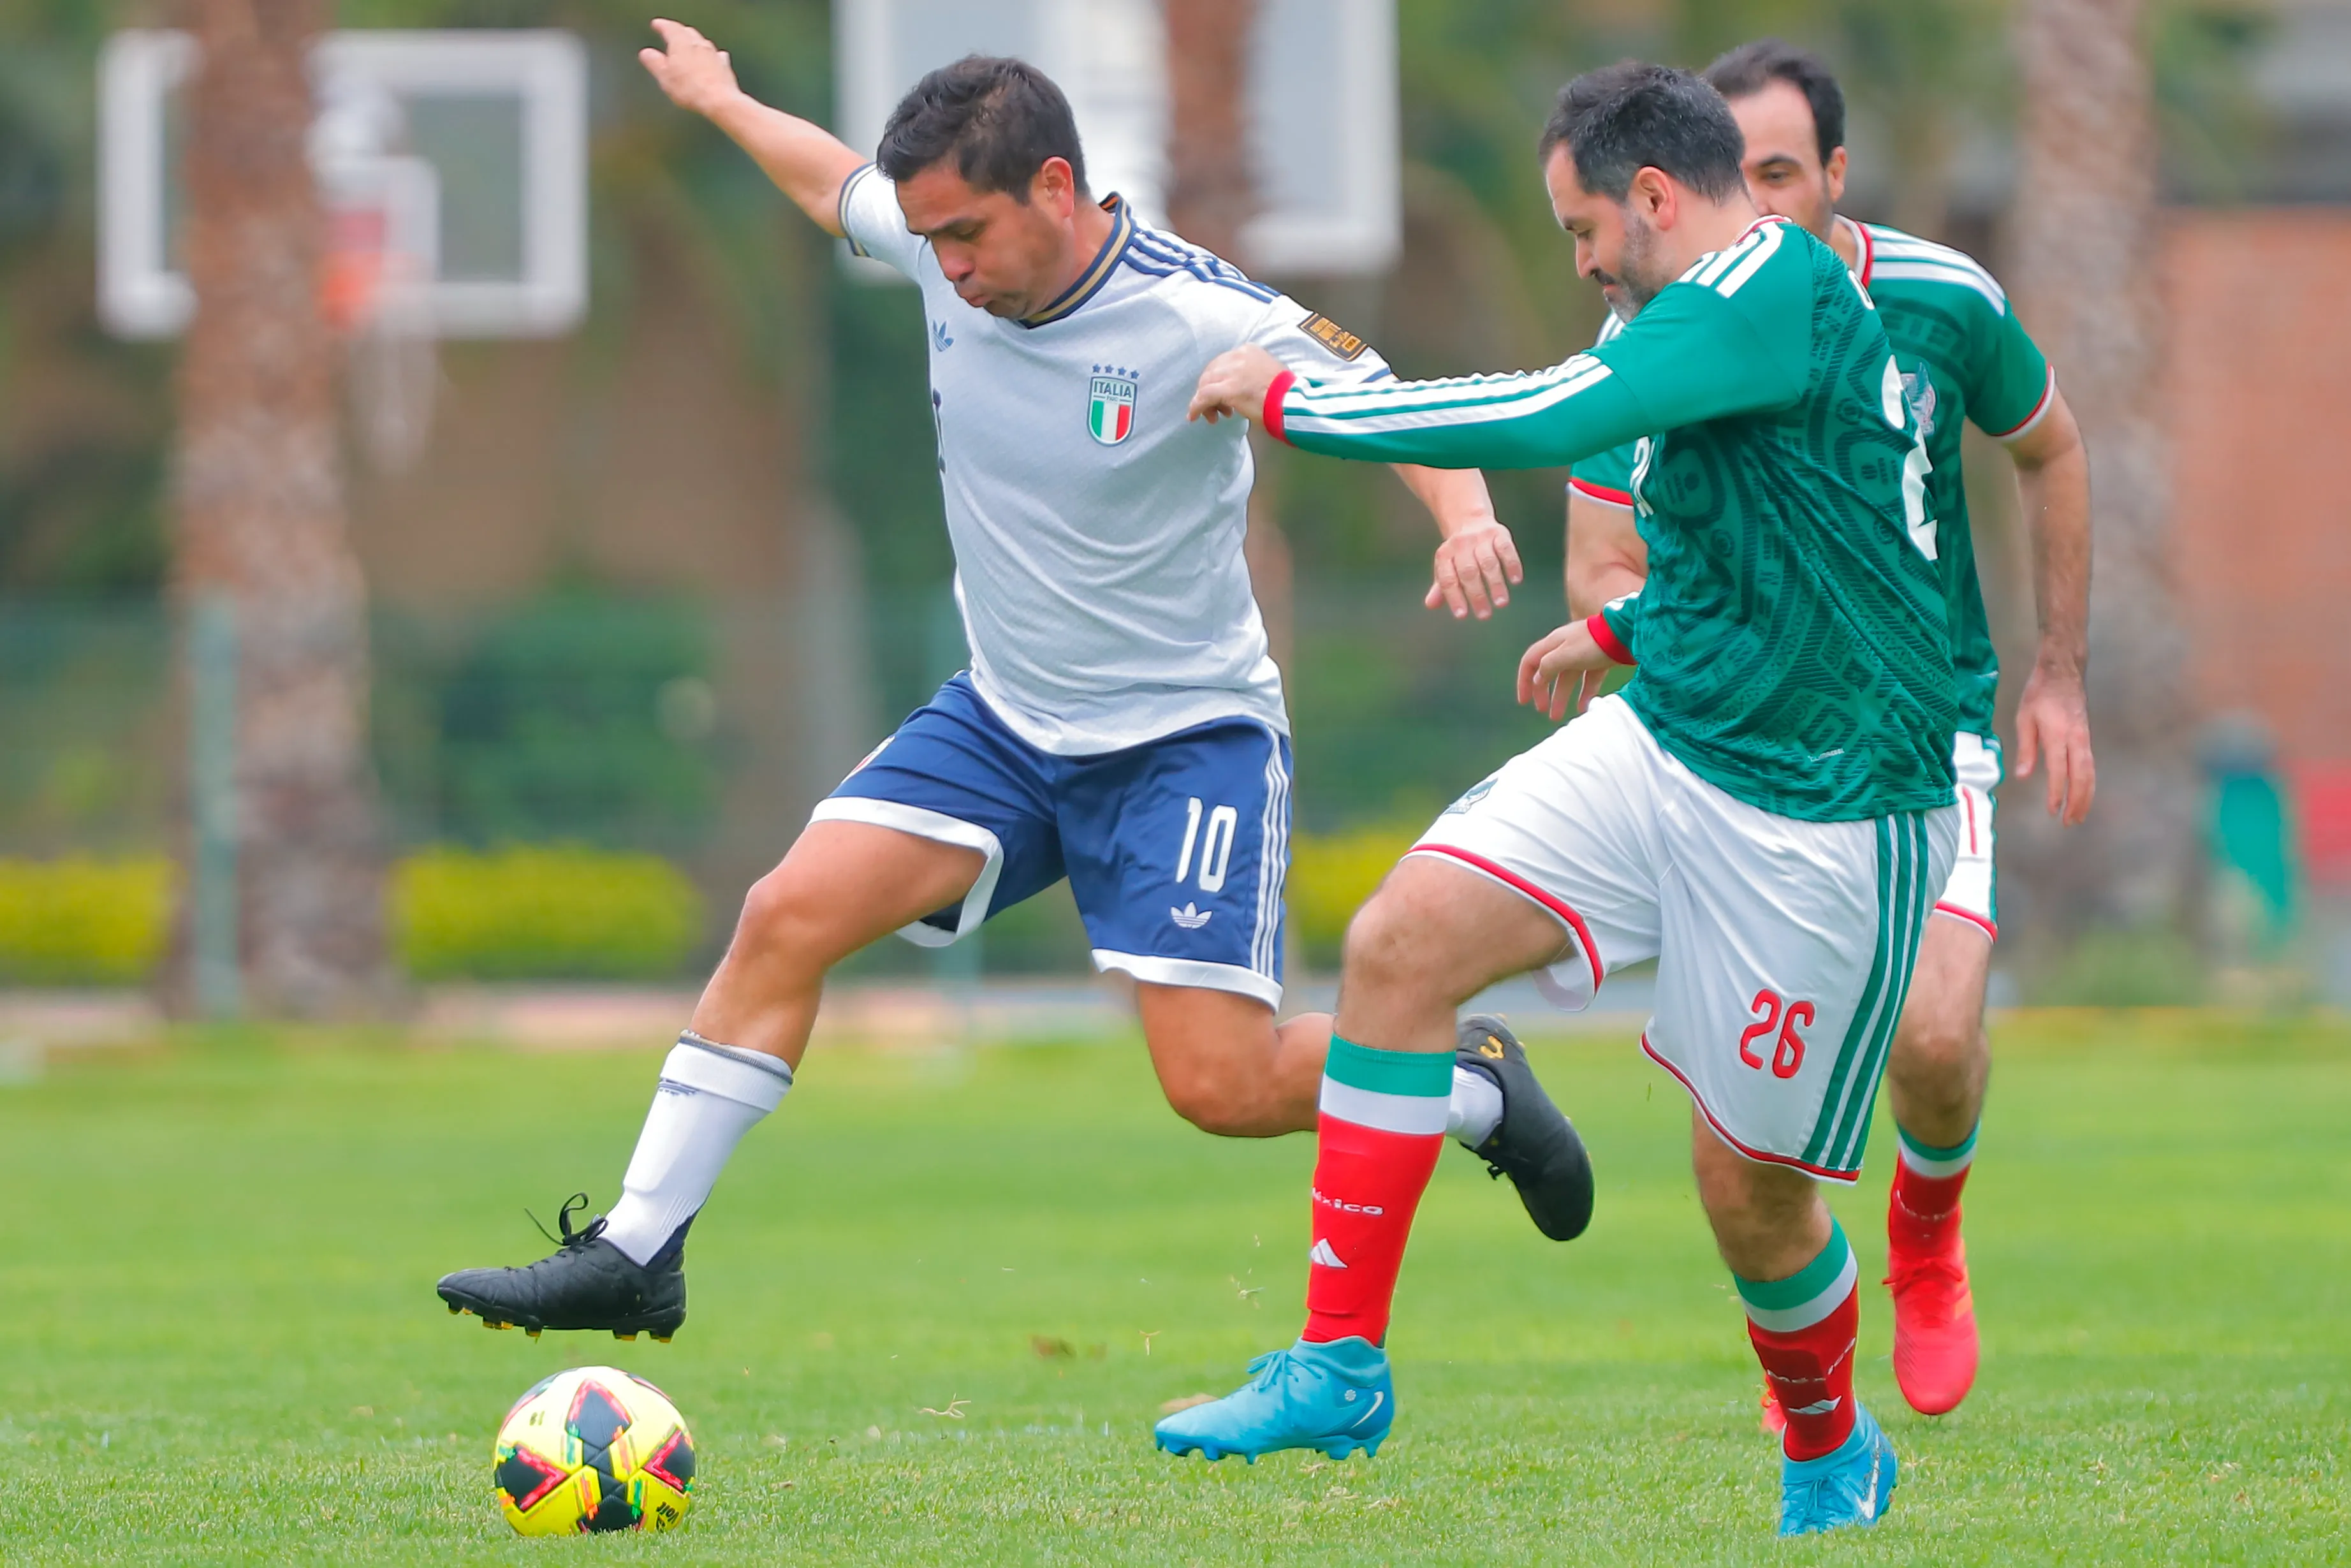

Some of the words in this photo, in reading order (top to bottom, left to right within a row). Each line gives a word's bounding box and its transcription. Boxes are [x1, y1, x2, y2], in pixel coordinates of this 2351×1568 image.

[1093, 381, 1132, 399] ITALIA
[1175, 796, 1239, 893] 10
[1739, 988, 1816, 1079] 26
